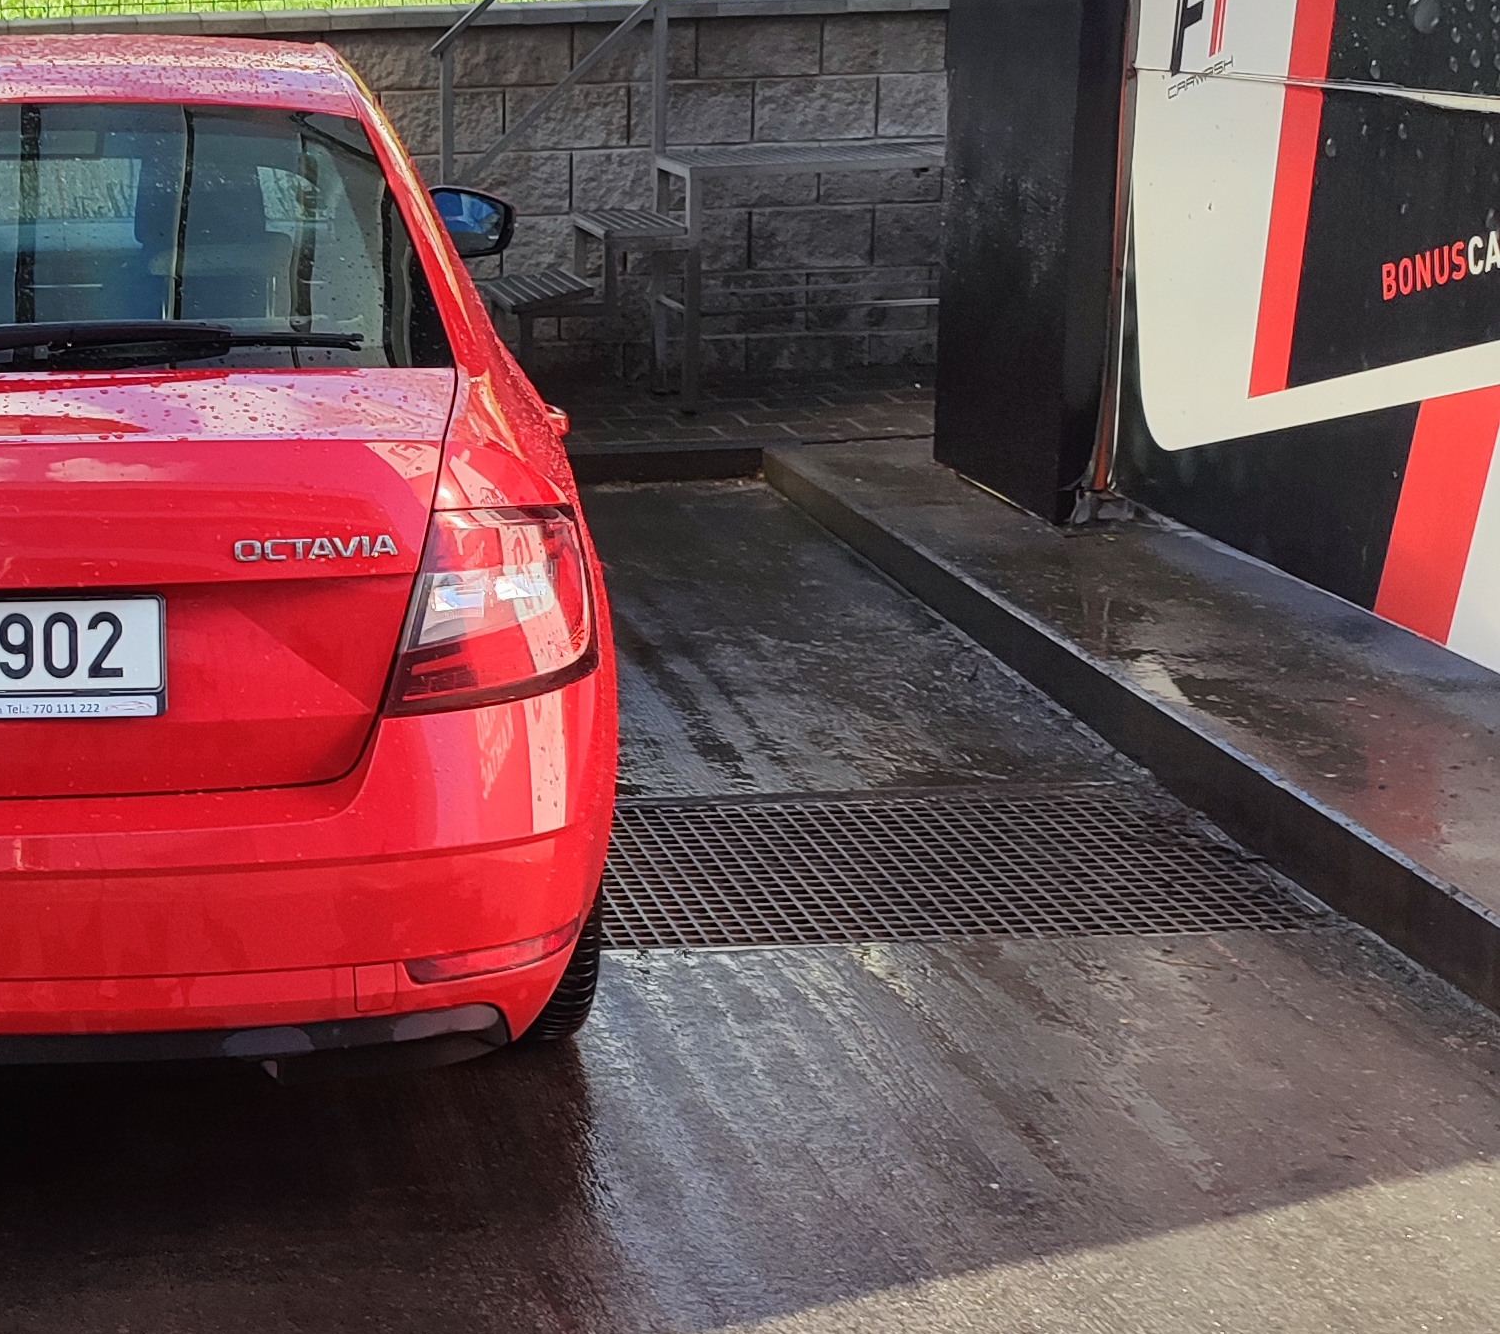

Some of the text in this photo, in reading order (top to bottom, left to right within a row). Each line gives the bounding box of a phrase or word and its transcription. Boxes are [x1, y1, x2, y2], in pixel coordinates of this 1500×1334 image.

[234, 534, 399, 562] OCTAVIA
[6, 704, 30, 714] Tel.:
[32, 704, 53, 714] 770
[56, 703, 76, 714] 111
[79, 703, 100, 713] 222
